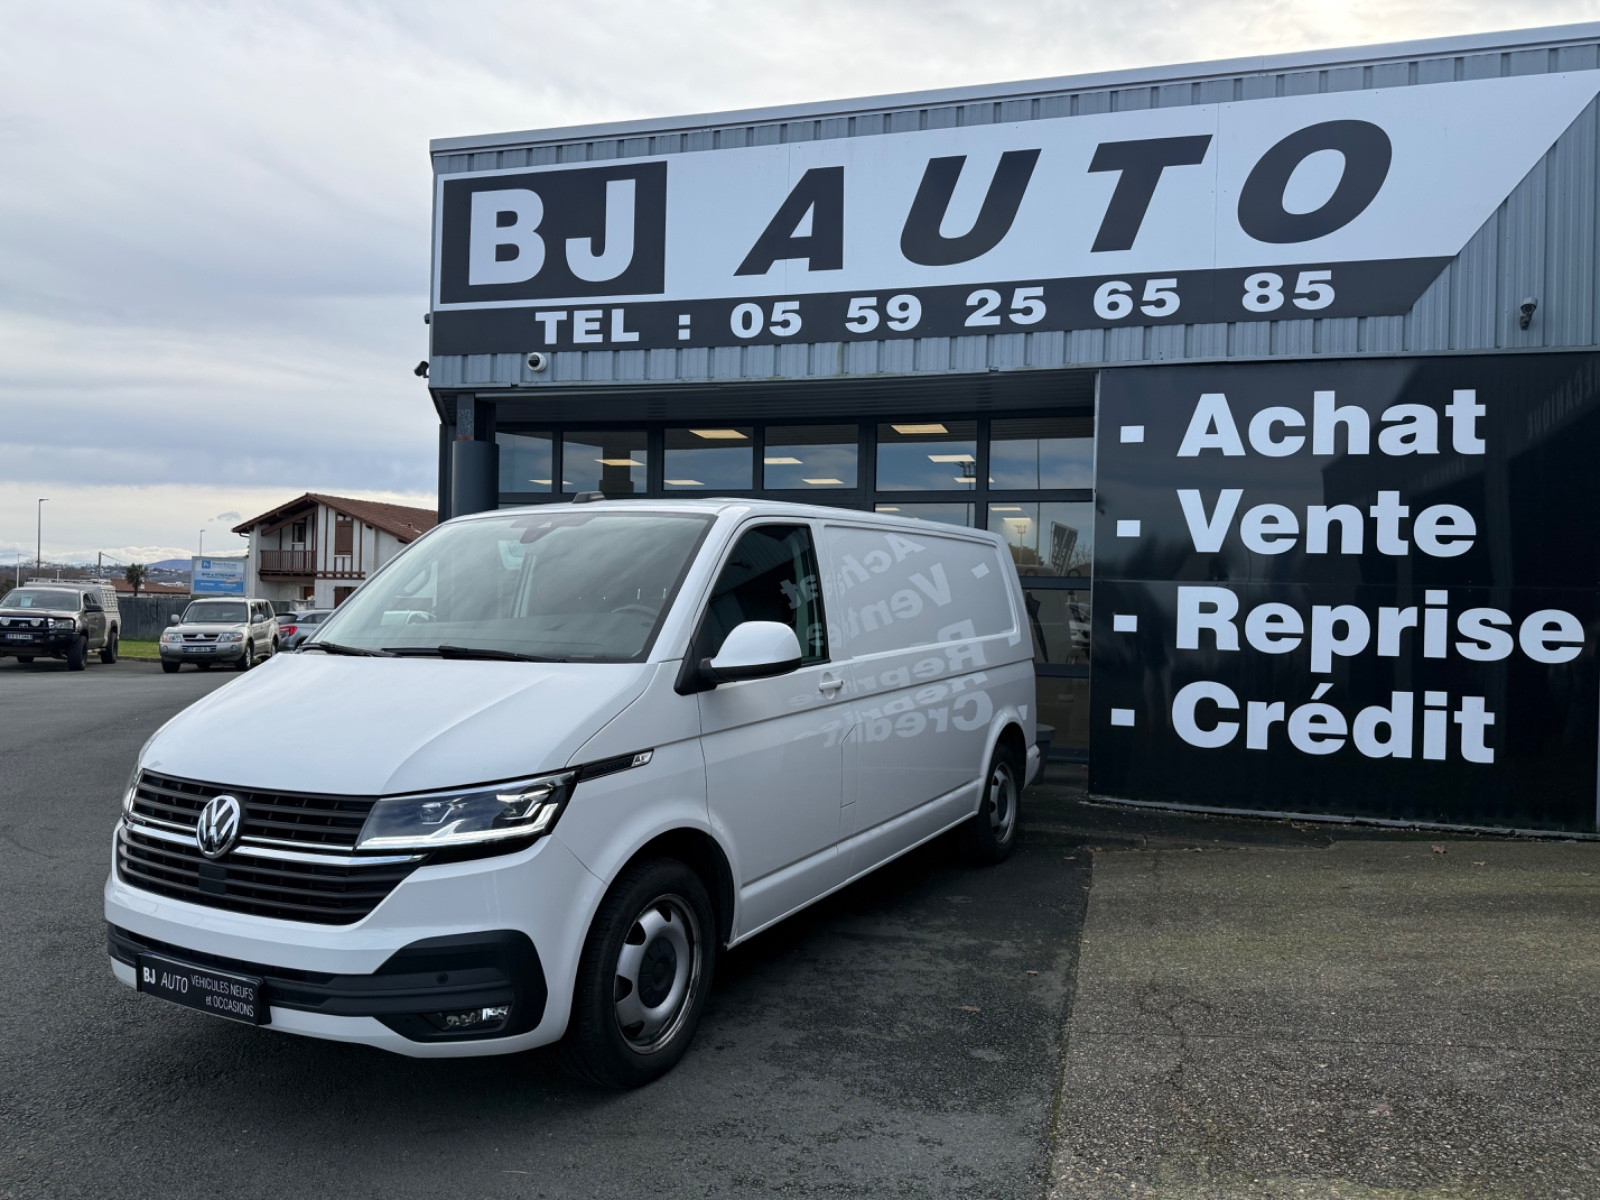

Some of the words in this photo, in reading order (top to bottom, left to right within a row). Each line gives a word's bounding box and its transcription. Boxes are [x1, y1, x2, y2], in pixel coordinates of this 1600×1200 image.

[469, 179, 636, 286] BJ
[733, 119, 1393, 276] AUTO
[535, 309, 639, 344] TEL
[731, 301, 801, 338] 05
[845, 294, 922, 333] 59
[965, 286, 1047, 326] 25
[1093, 278, 1181, 319] 65
[1242, 270, 1335, 312] 85
[1177, 389, 1486, 457] Achat
[1177, 489, 1476, 557] Vente
[1177, 586, 1585, 673] Reprise
[1172, 681, 1495, 764] Crédit
[143, 967, 156, 985] BJ
[161, 972, 187, 993] AUTO
[191, 975, 229, 994] VEHICULES
[230, 983, 254, 1001] NEUFS
[205, 995, 213, 1006] et
[213, 995, 254, 1018] OCCASIONS
